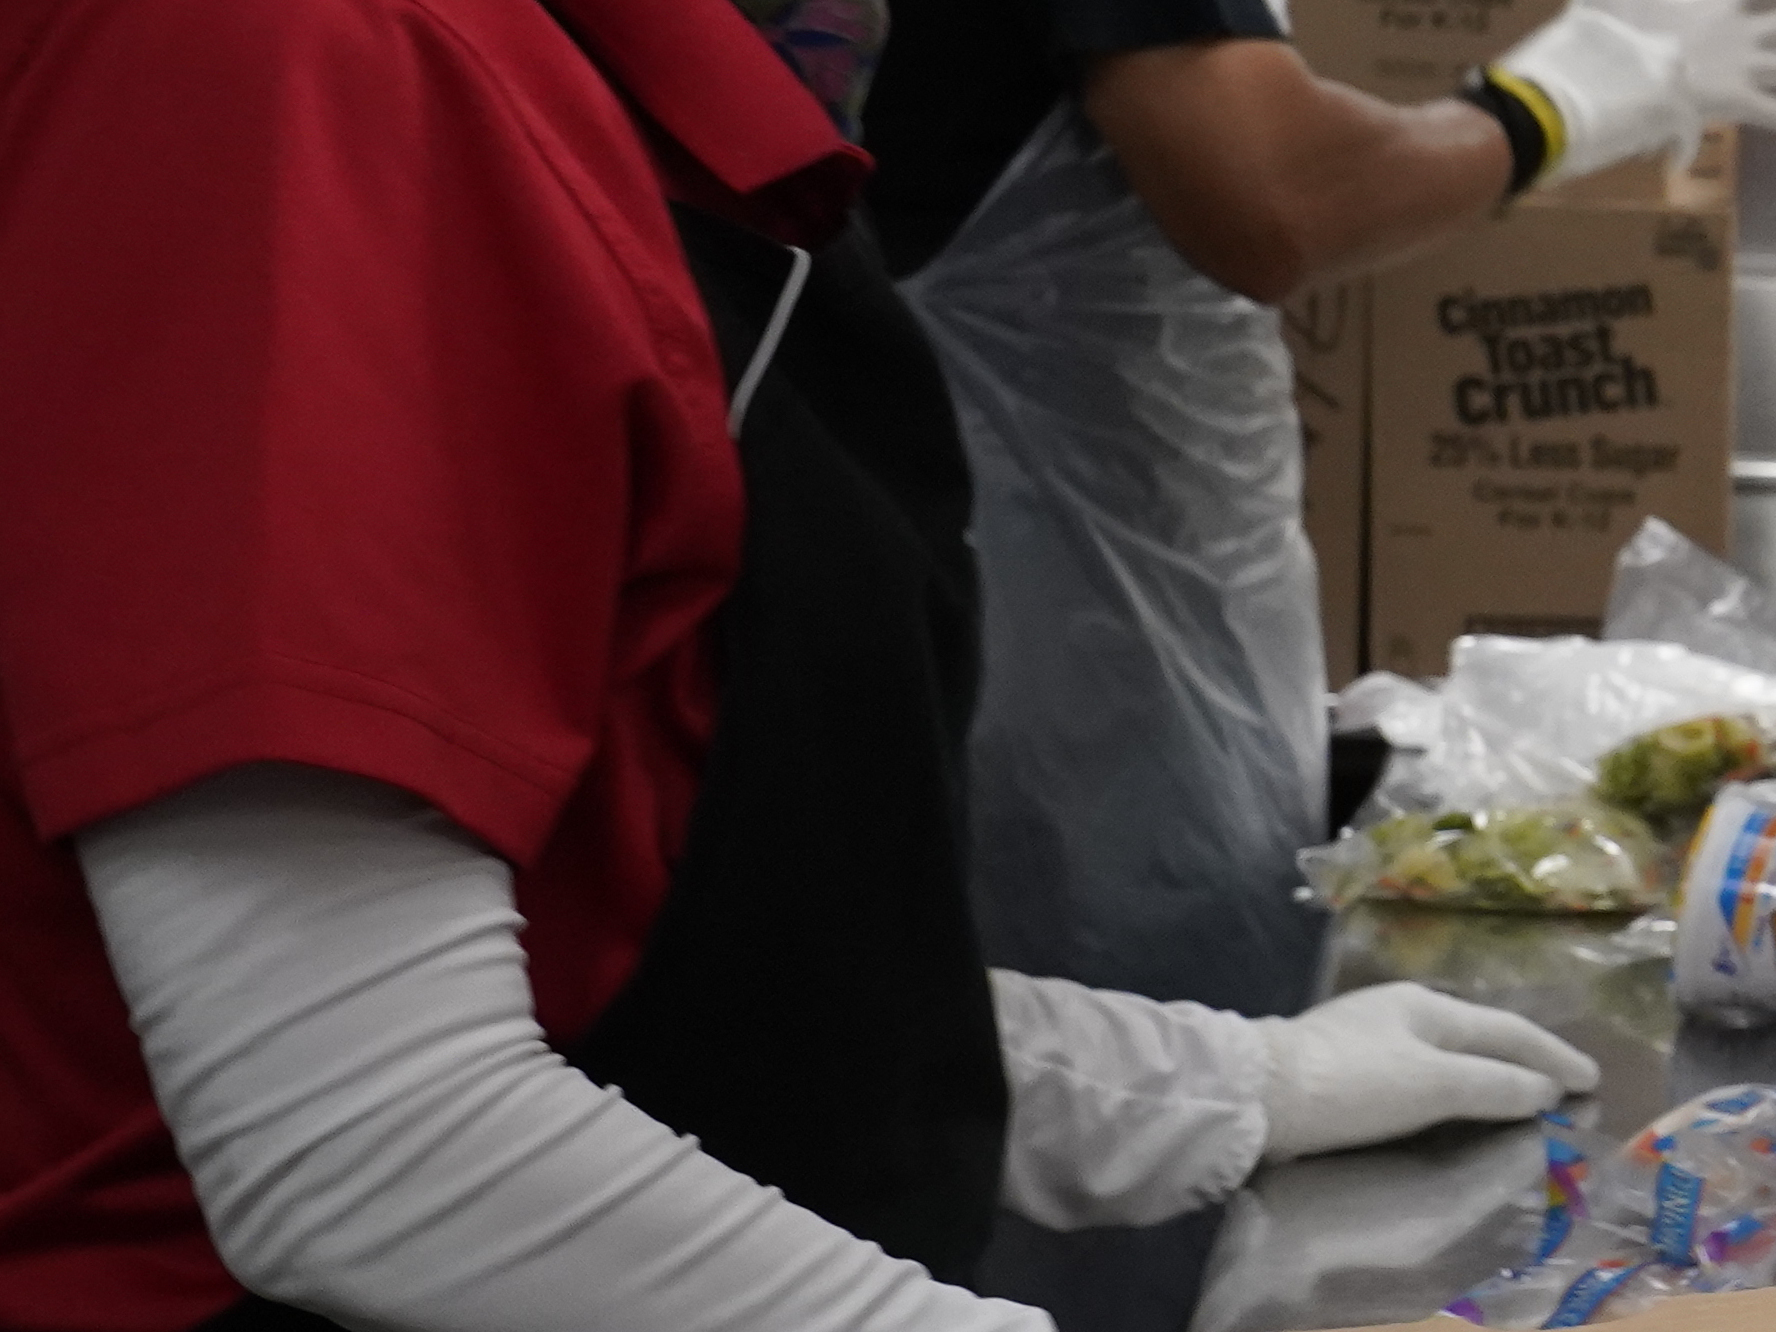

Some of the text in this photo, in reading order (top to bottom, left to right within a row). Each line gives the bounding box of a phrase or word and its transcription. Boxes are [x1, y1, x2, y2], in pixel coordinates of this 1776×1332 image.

[1437, 284, 1653, 335] Cinnamon
[1480, 323, 1618, 373] Toast
[1454, 357, 1657, 425] Crunch
[1430, 432, 1681, 480] 25% Less Sugar
